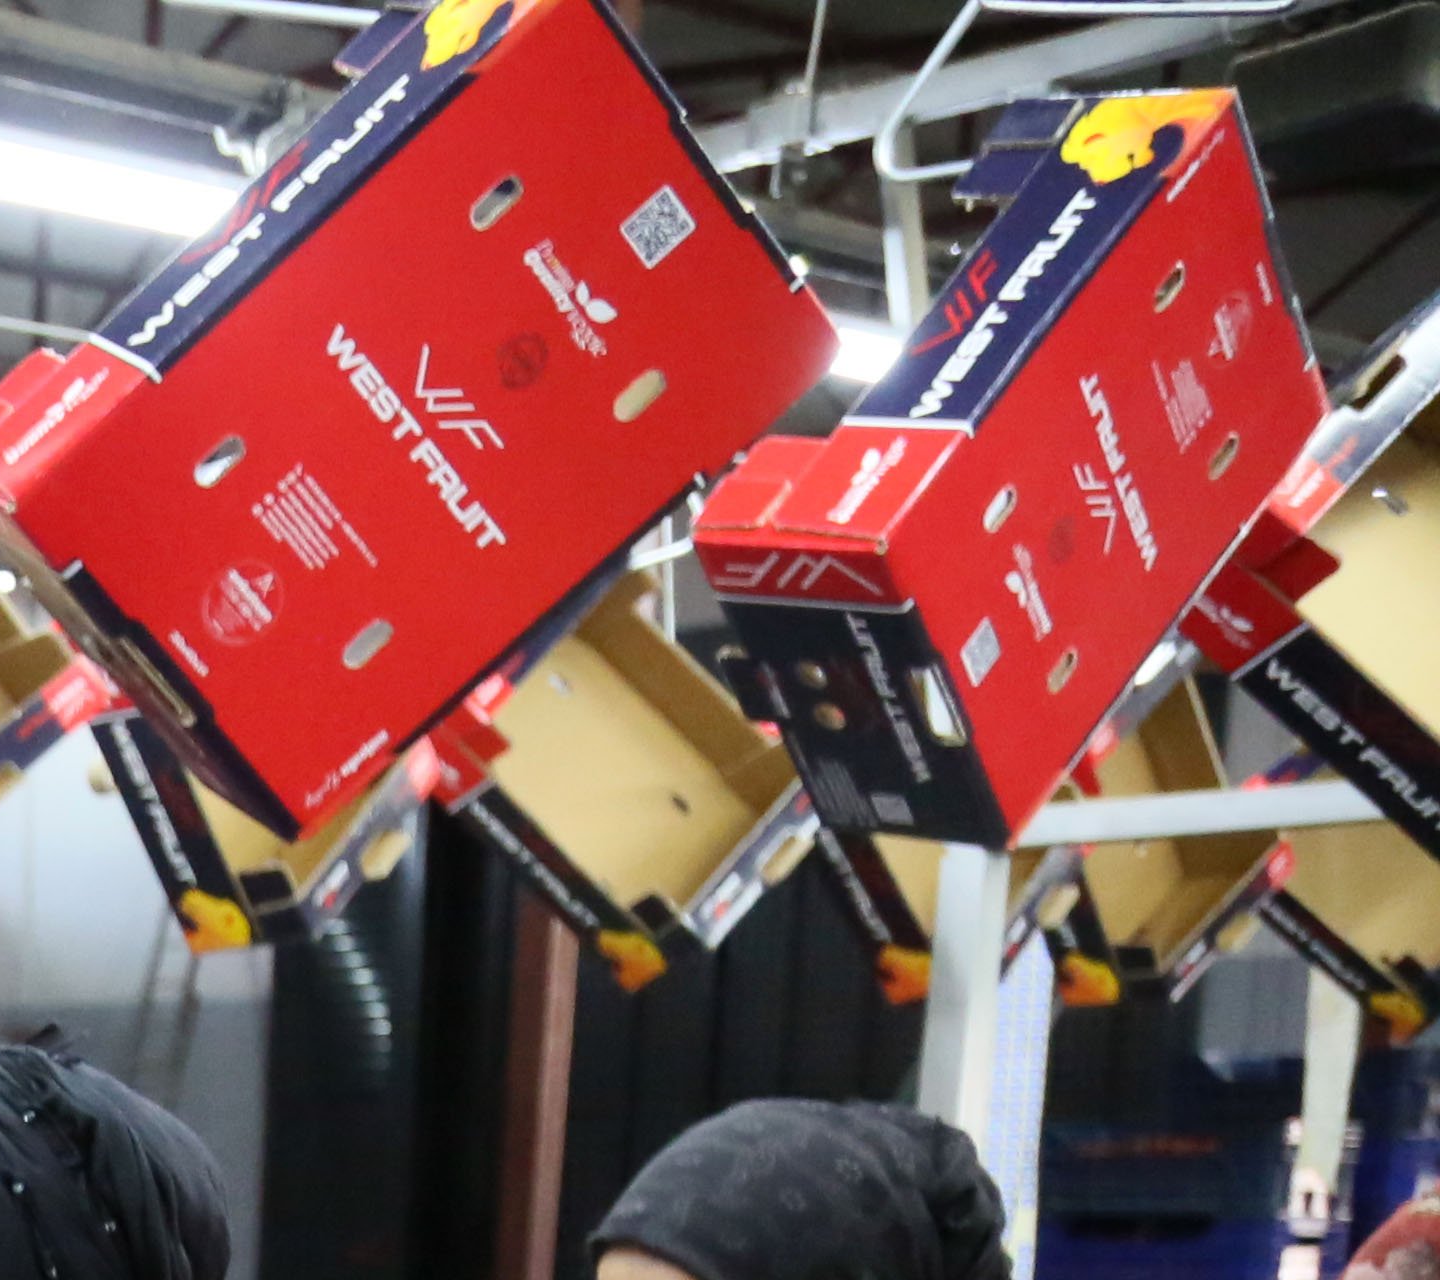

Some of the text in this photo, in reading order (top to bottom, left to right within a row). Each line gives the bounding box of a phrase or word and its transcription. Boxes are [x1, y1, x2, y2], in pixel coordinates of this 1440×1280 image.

[127, 73, 410, 347] WEST FRUIT
[909, 187, 1097, 420] WEST FRUIT
[326, 322, 507, 550] WEST FRUIT
[415, 343, 505, 450] WF
[1265, 657, 1440, 832] WEST FRUI
